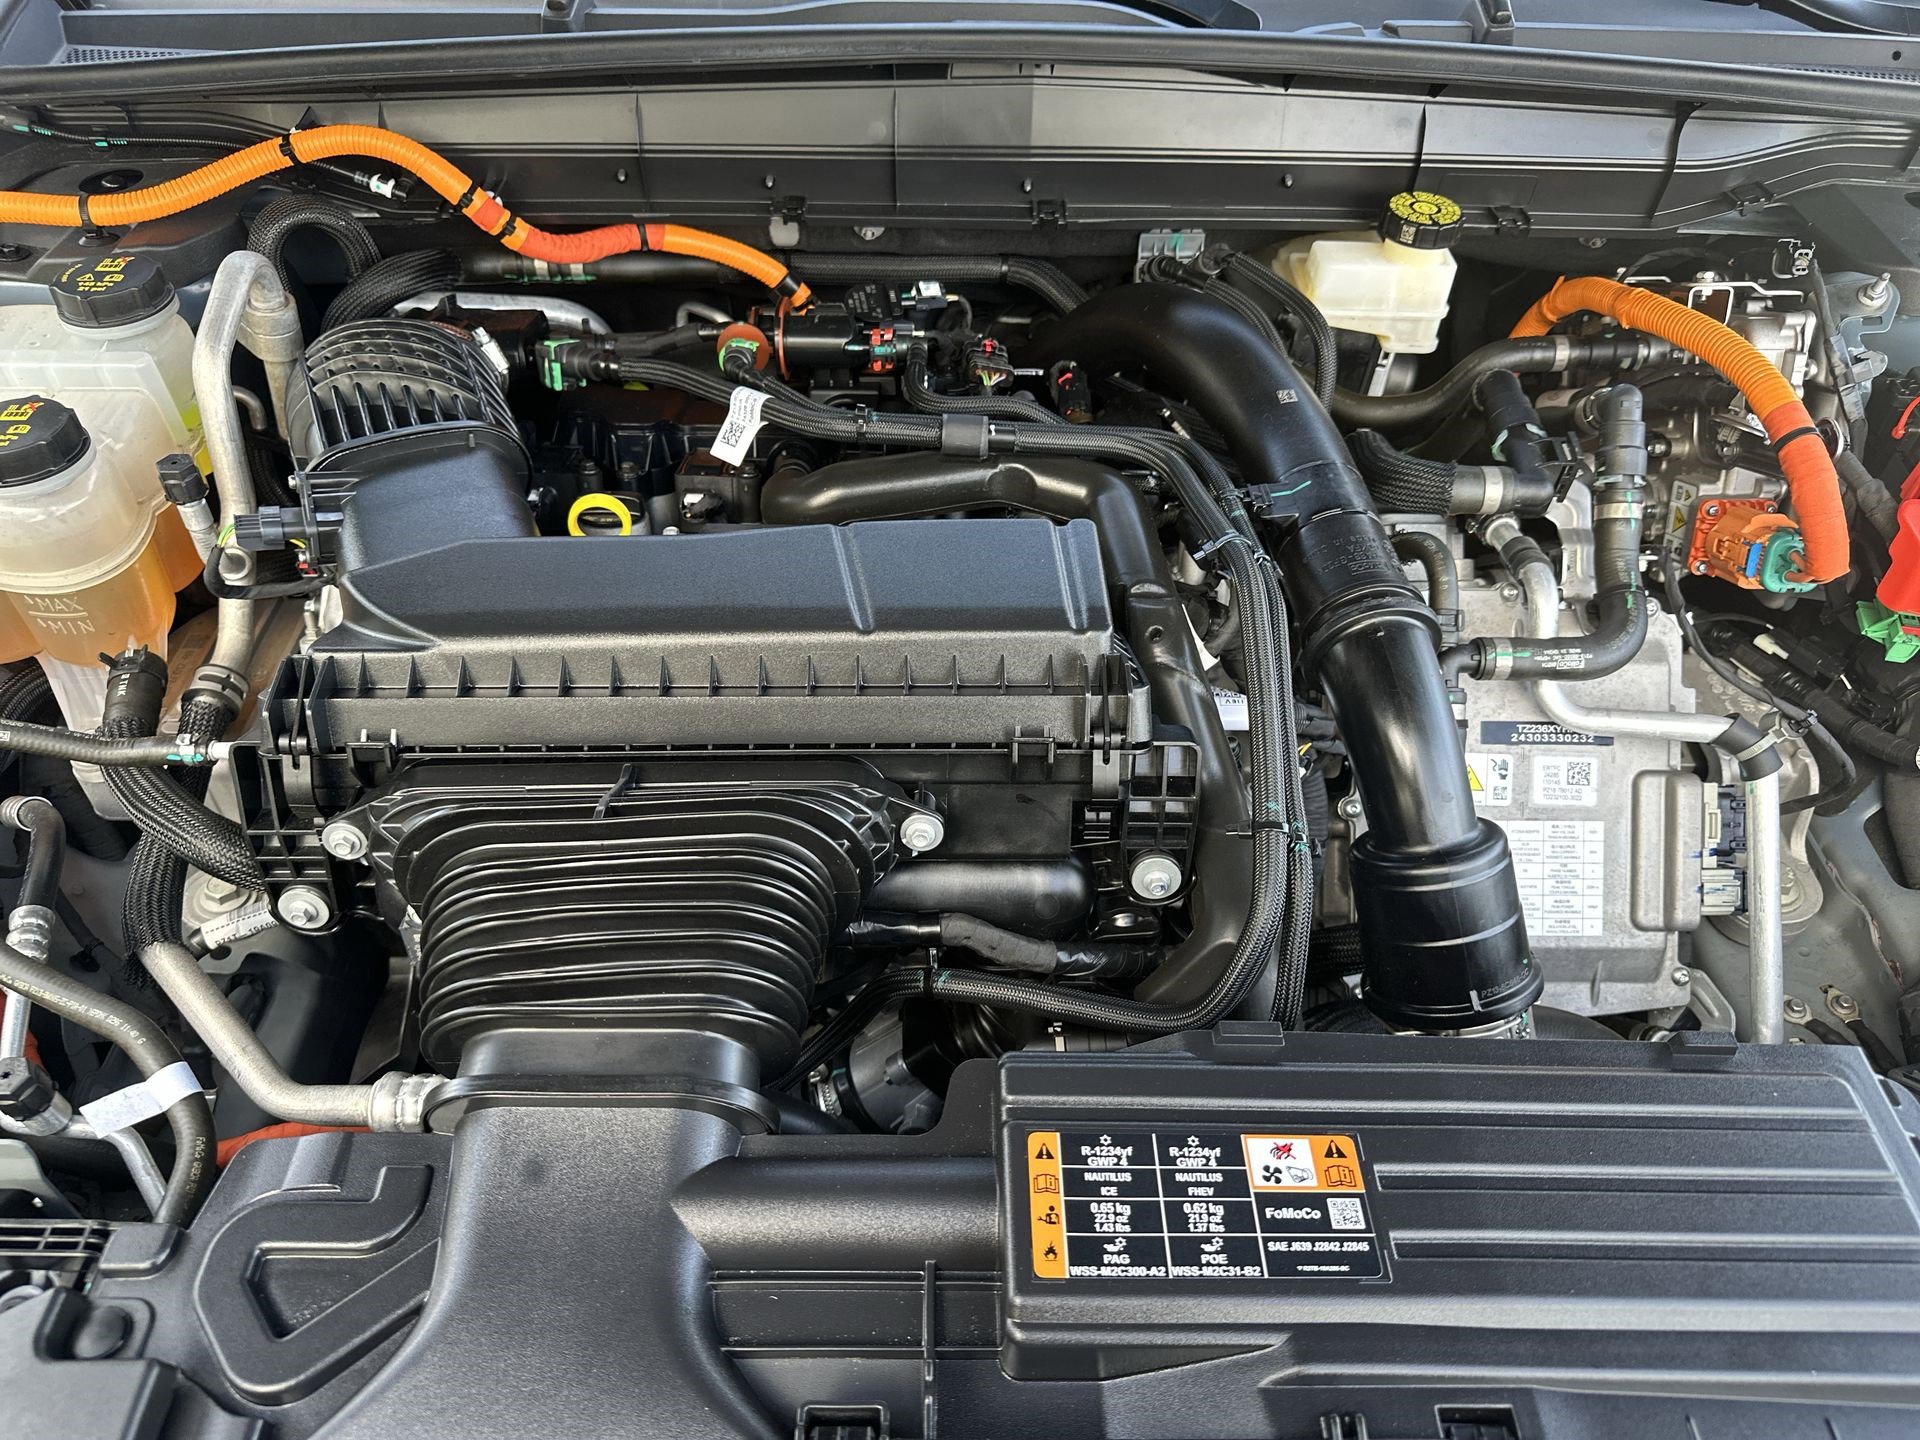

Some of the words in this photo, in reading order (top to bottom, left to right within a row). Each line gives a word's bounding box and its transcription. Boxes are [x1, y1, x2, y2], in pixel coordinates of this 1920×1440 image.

[34, 596, 84, 612] MAX
[47, 619, 96, 635] MIN
[1510, 733, 1595, 743] 24303330232
[1081, 1146, 1133, 1158] R-1234yf
[1169, 1147, 1221, 1158] R-1234yf
[1087, 1156, 1118, 1166] GWP
[1119, 1157, 1129, 1166] 4
[1176, 1157, 1207, 1167] GWP
[1208, 1158, 1218, 1167] 4
[1084, 1172, 1132, 1182] NAUTILUS
[1175, 1172, 1224, 1182] NAUTILUS
[1100, 1186, 1119, 1196] ICE
[1187, 1186, 1214, 1196] FHEV
[1090, 1202, 1115, 1214] 0.65
[1115, 1202, 1132, 1216] kg
[1183, 1202, 1208, 1214] 0.62
[1208, 1202, 1225, 1216] kg
[1265, 1207, 1322, 1219] FoMoCo
[1094, 1213, 1115, 1223] 22.9
[1115, 1215, 1129, 1223] oz
[1187, 1213, 1209, 1223] 21.9
[1209, 1215, 1223, 1223] oz
[1093, 1223, 1115, 1232] 1.43
[1115, 1223, 1131, 1232] lbs
[1187, 1223, 1208, 1232] 1.37
[1209, 1223, 1225, 1232] lbs
[1267, 1241, 1289, 1251] SAE
[1290, 1241, 1313, 1251] J639
[1313, 1241, 1341, 1251] J2842
[1341, 1241, 1370, 1251] J2845
[1103, 1254, 1131, 1264] PAG
[1200, 1254, 1229, 1264] POE
[1069, 1266, 1167, 1277] WSS-M2C300-A2
[1171, 1266, 1262, 1277] WSS-M2C31-B2
